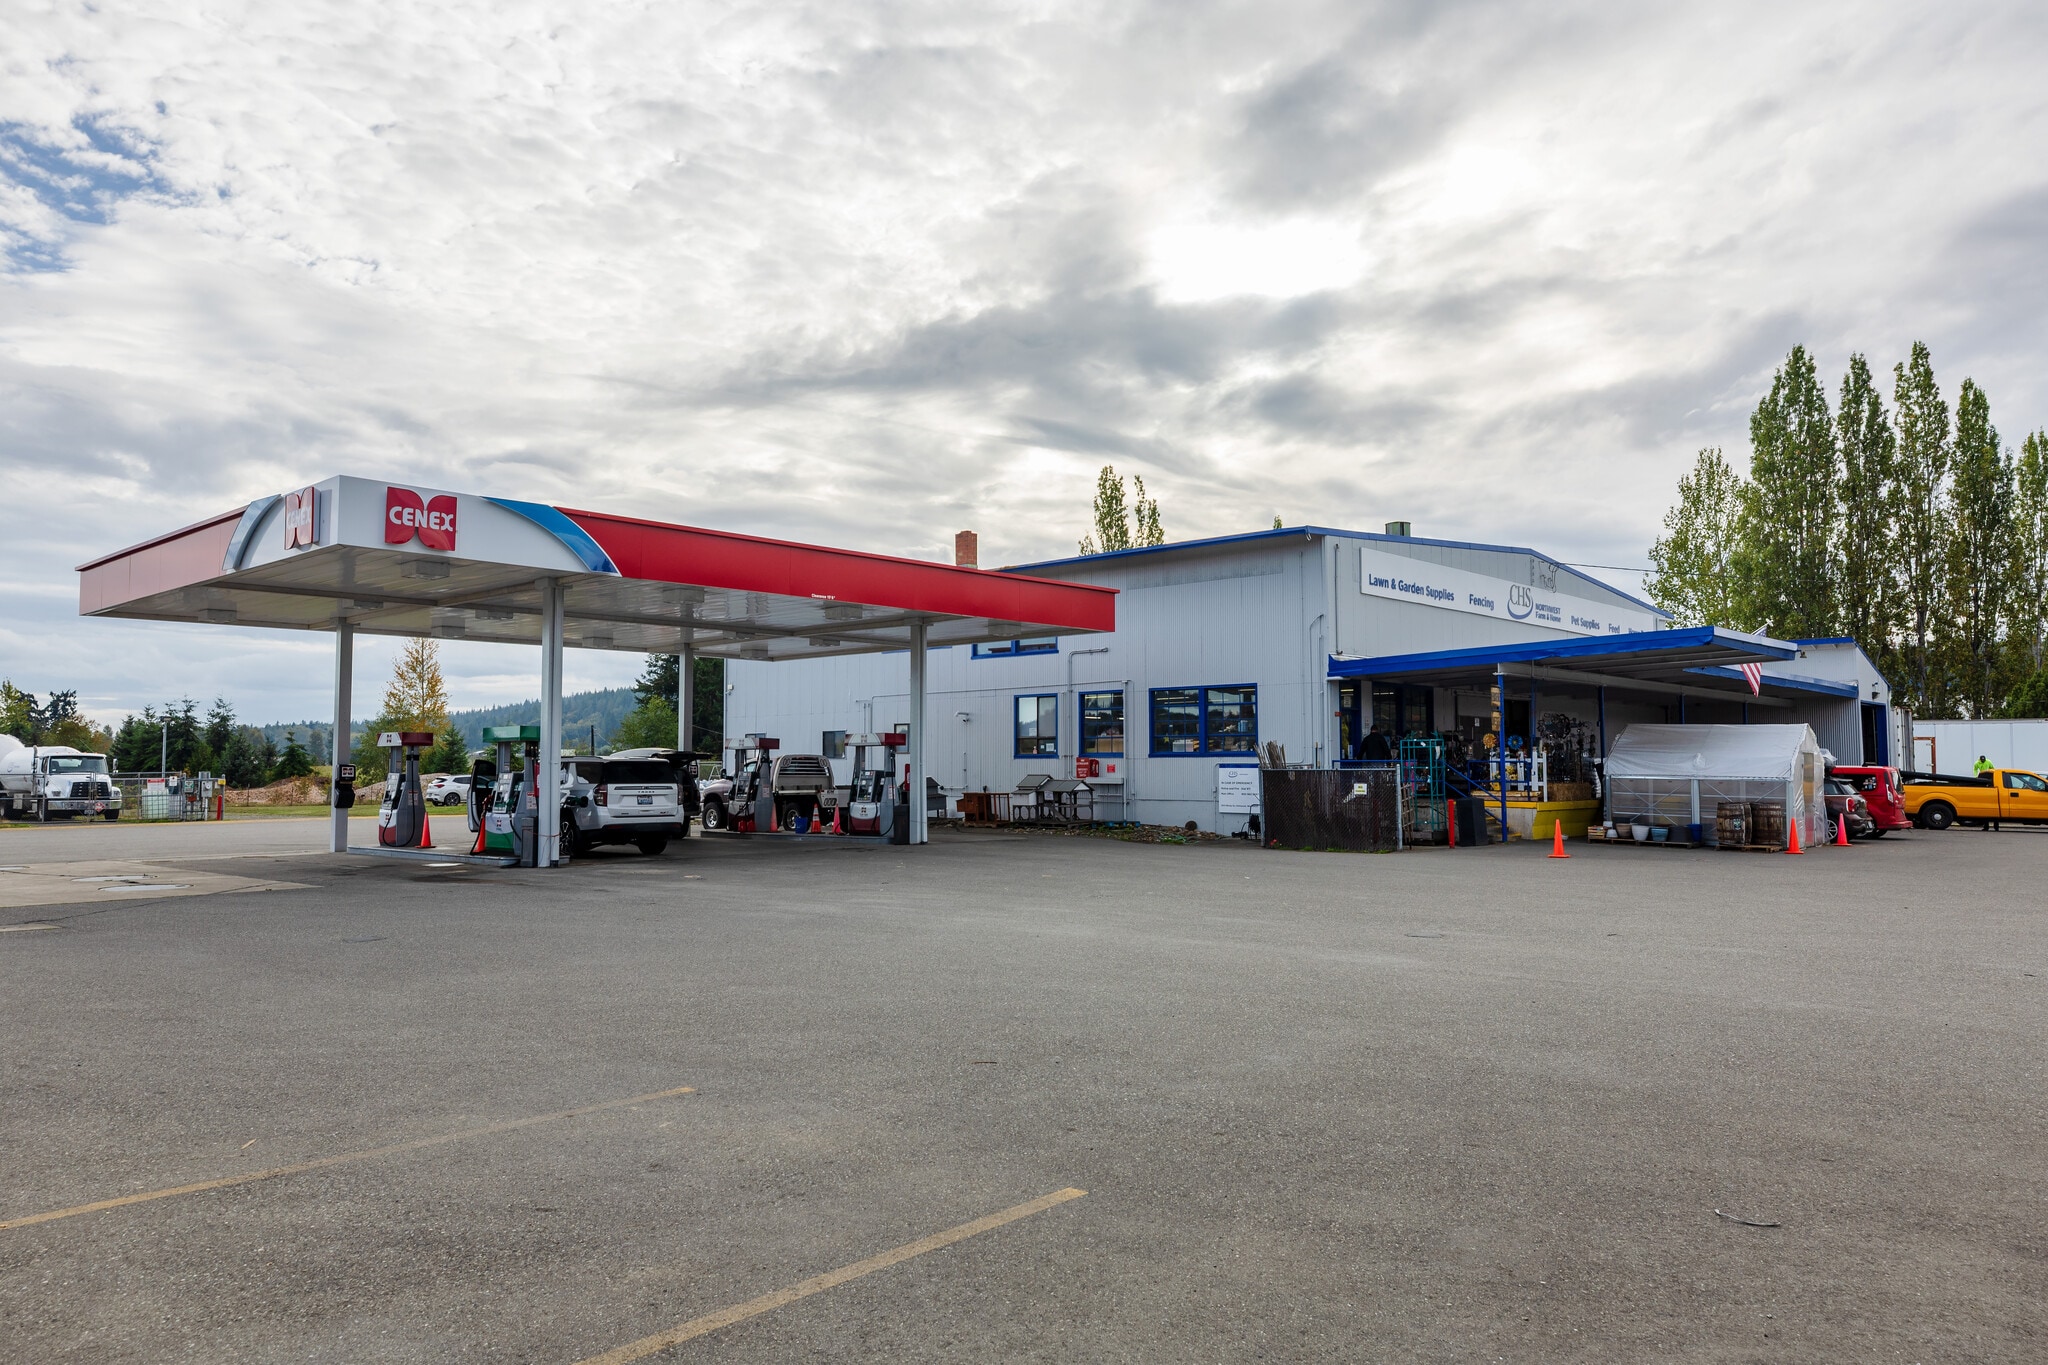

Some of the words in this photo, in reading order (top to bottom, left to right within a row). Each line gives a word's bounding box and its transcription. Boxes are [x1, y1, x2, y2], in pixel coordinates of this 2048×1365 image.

[389, 506, 454, 532] CENEX
[1368, 573, 1389, 588] Lawn
[1390, 578, 1397, 590] &
[1398, 579, 1424, 596] Garden
[1425, 585, 1455, 602] Supplies
[1509, 584, 1531, 608] CHS
[1468, 593, 1495, 611] Fencing
[1570, 615, 1580, 626] Pet
[1580, 617, 1600, 630] Supplies
[1608, 623, 1620, 633] Feed
